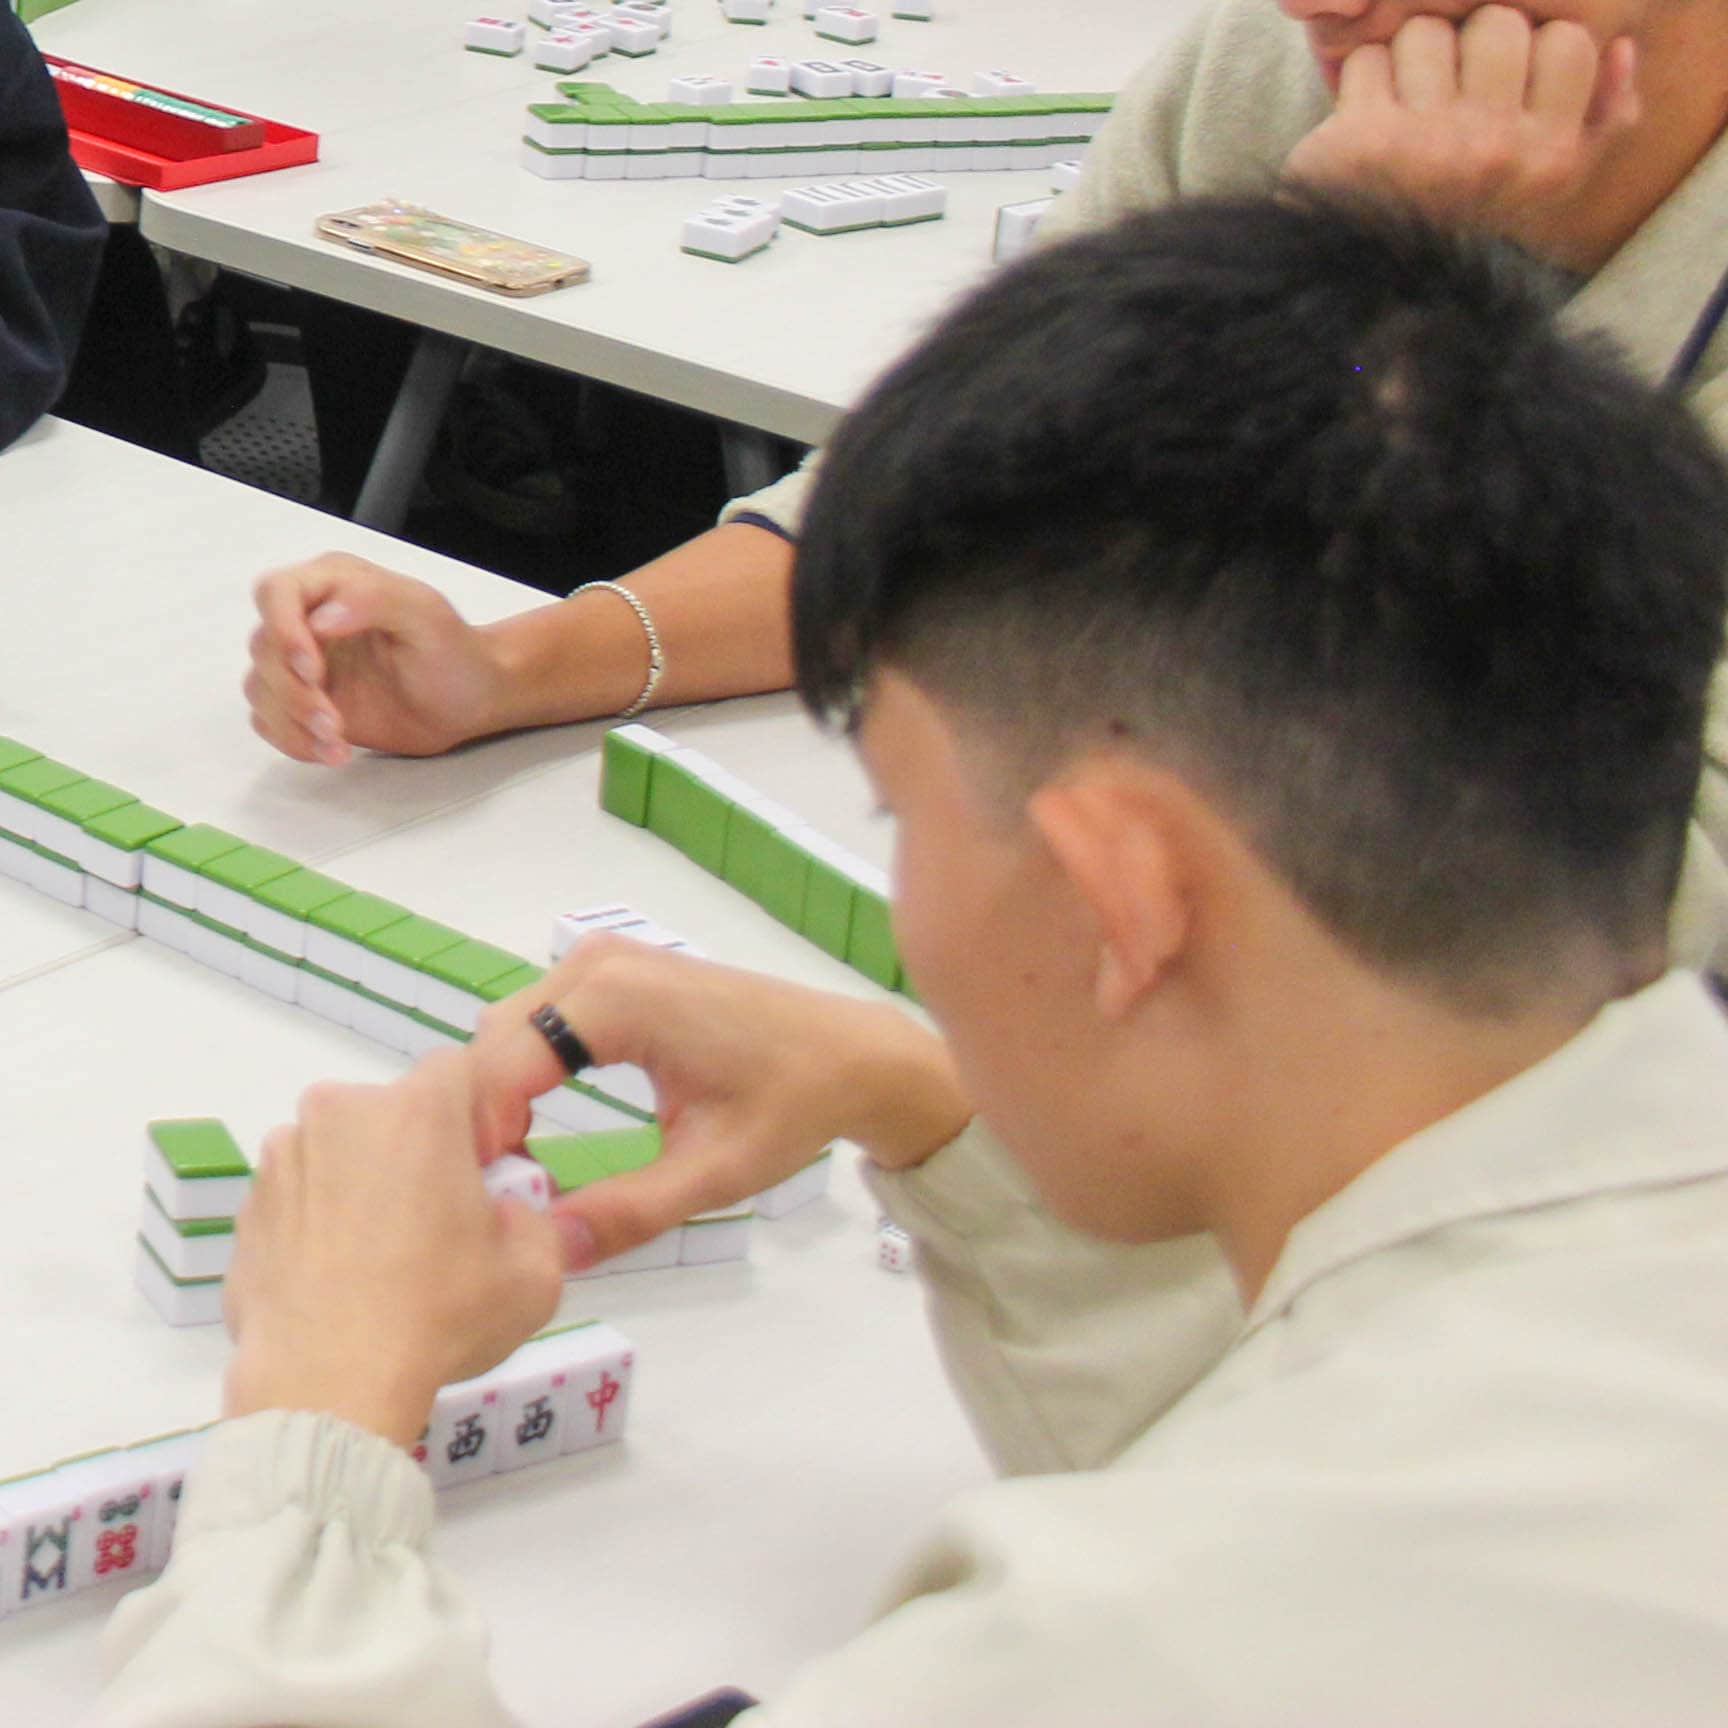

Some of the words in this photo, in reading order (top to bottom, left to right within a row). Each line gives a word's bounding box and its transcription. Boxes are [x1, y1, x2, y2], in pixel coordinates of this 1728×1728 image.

[516, 1395, 555, 1446] 西
[586, 1371, 621, 1433] 中
[447, 1413, 486, 1462] 西
